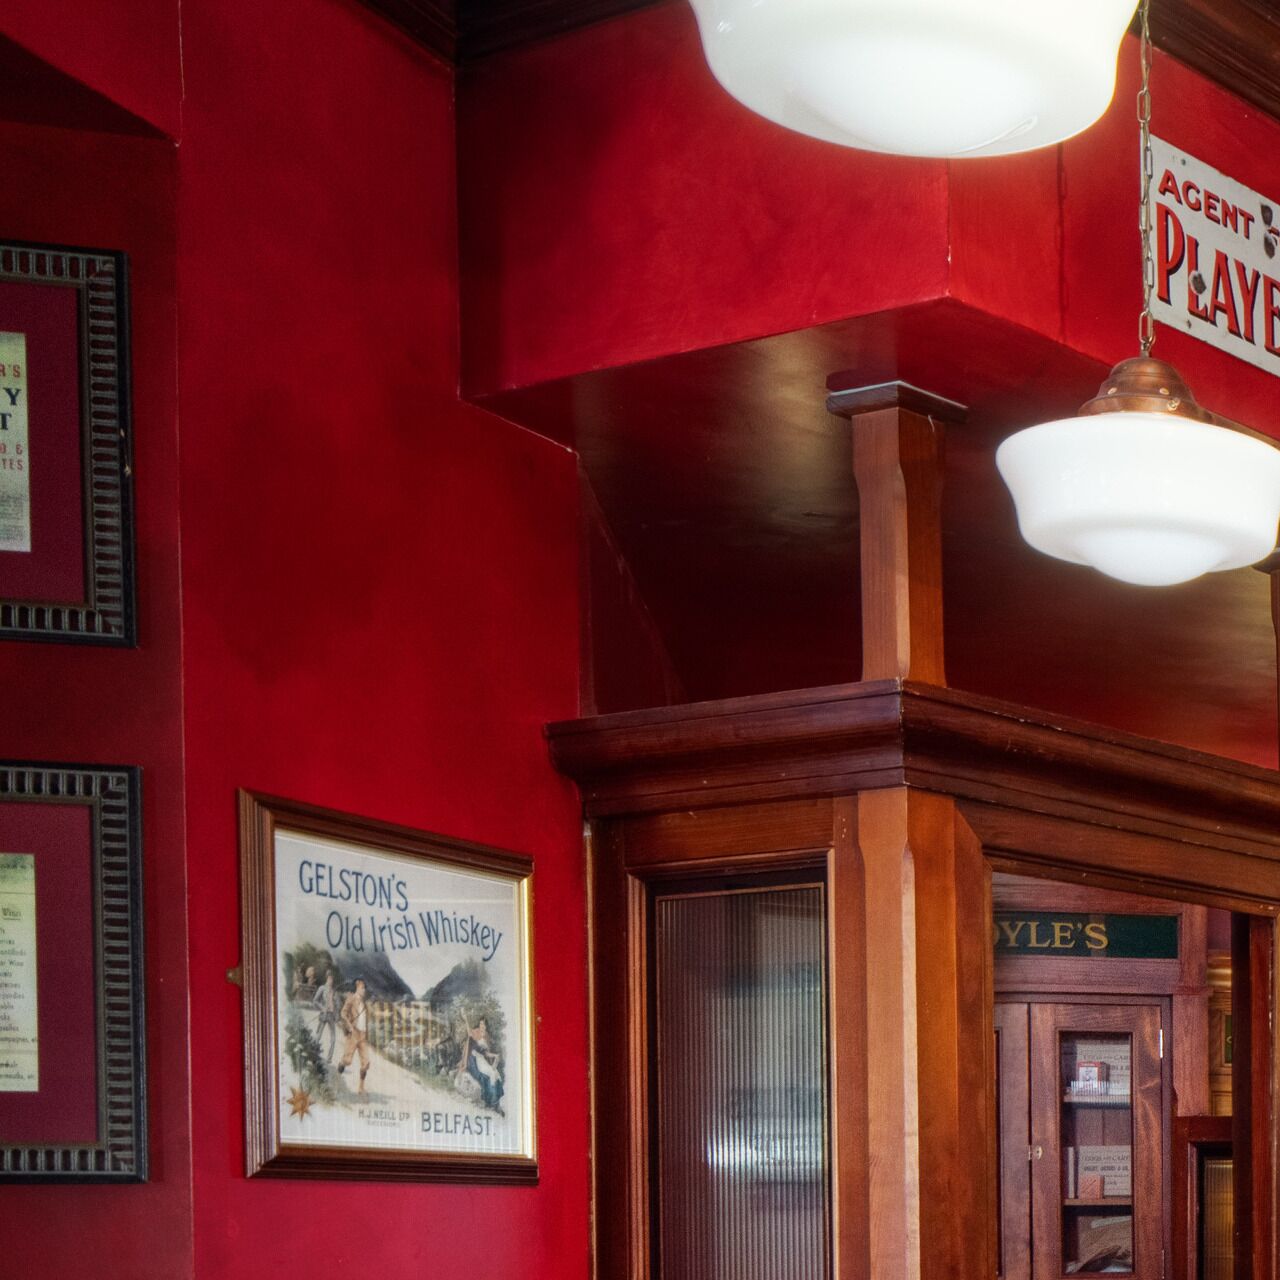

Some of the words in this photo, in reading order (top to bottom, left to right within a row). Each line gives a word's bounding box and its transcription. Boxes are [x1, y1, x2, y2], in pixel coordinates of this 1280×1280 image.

[1158, 168, 1255, 239] AGENT
[298, 859, 410, 912] GELSTON'S
[325, 910, 365, 953] Old
[370, 914, 420, 952] Irish
[420, 910, 503, 962] Whiskey
[993, 921, 1110, 950] YLE'S
